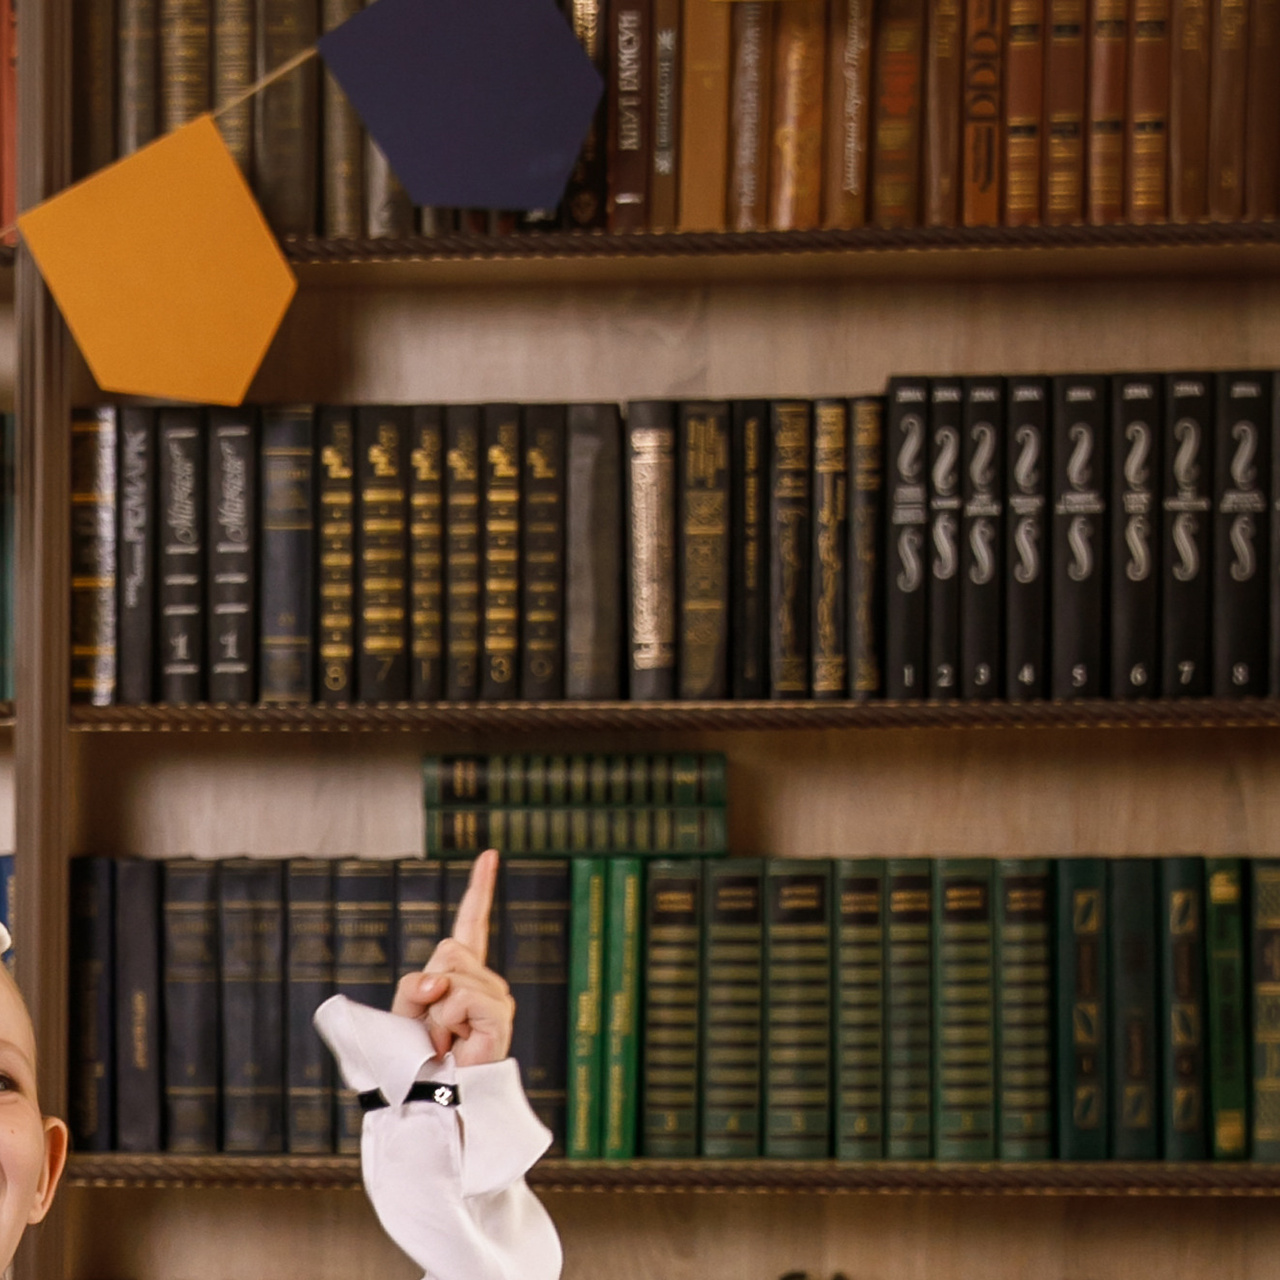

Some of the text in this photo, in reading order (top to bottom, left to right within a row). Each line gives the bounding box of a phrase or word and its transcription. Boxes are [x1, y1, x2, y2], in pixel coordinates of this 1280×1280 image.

[618, 9, 642, 92] ГАМСУН
[122, 429, 147, 544] РЕМАРК
[490, 656, 512, 683] 3
[903, 663, 914, 687] 1
[936, 663, 953, 687] 2
[974, 662, 991, 686] 3
[1017, 662, 1036, 686] 4
[1071, 662, 1088, 687] 5
[1130, 661, 1148, 686] 6
[1177, 660, 1196, 684] 7
[1231, 661, 1250, 686] 8
